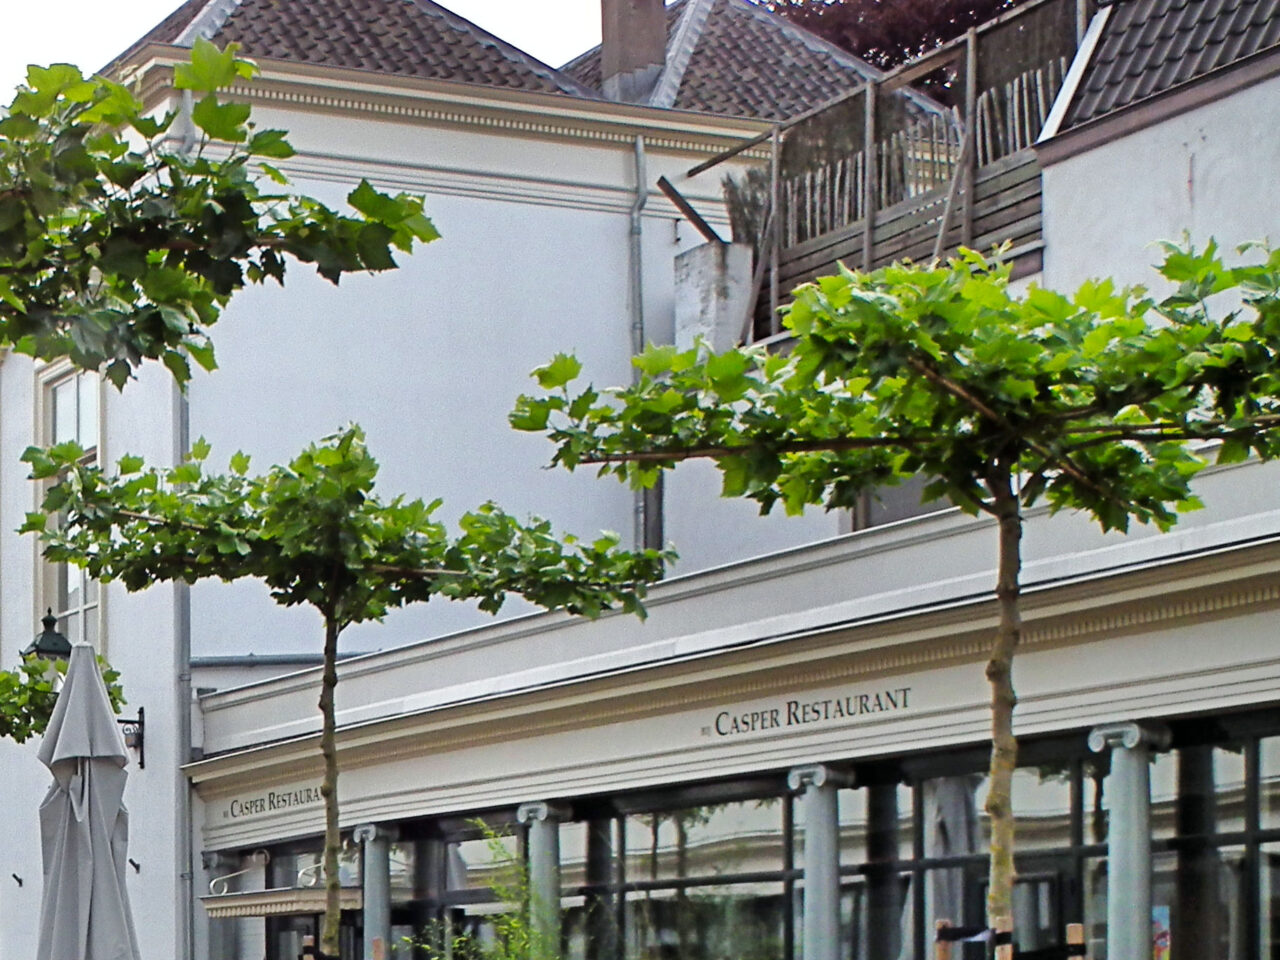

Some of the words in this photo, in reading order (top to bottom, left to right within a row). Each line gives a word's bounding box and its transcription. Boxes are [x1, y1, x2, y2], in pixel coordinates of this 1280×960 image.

[716, 709, 780, 736] CASPER
[786, 688, 911, 726] RESTAURANT
[230, 799, 266, 818] CASPER
